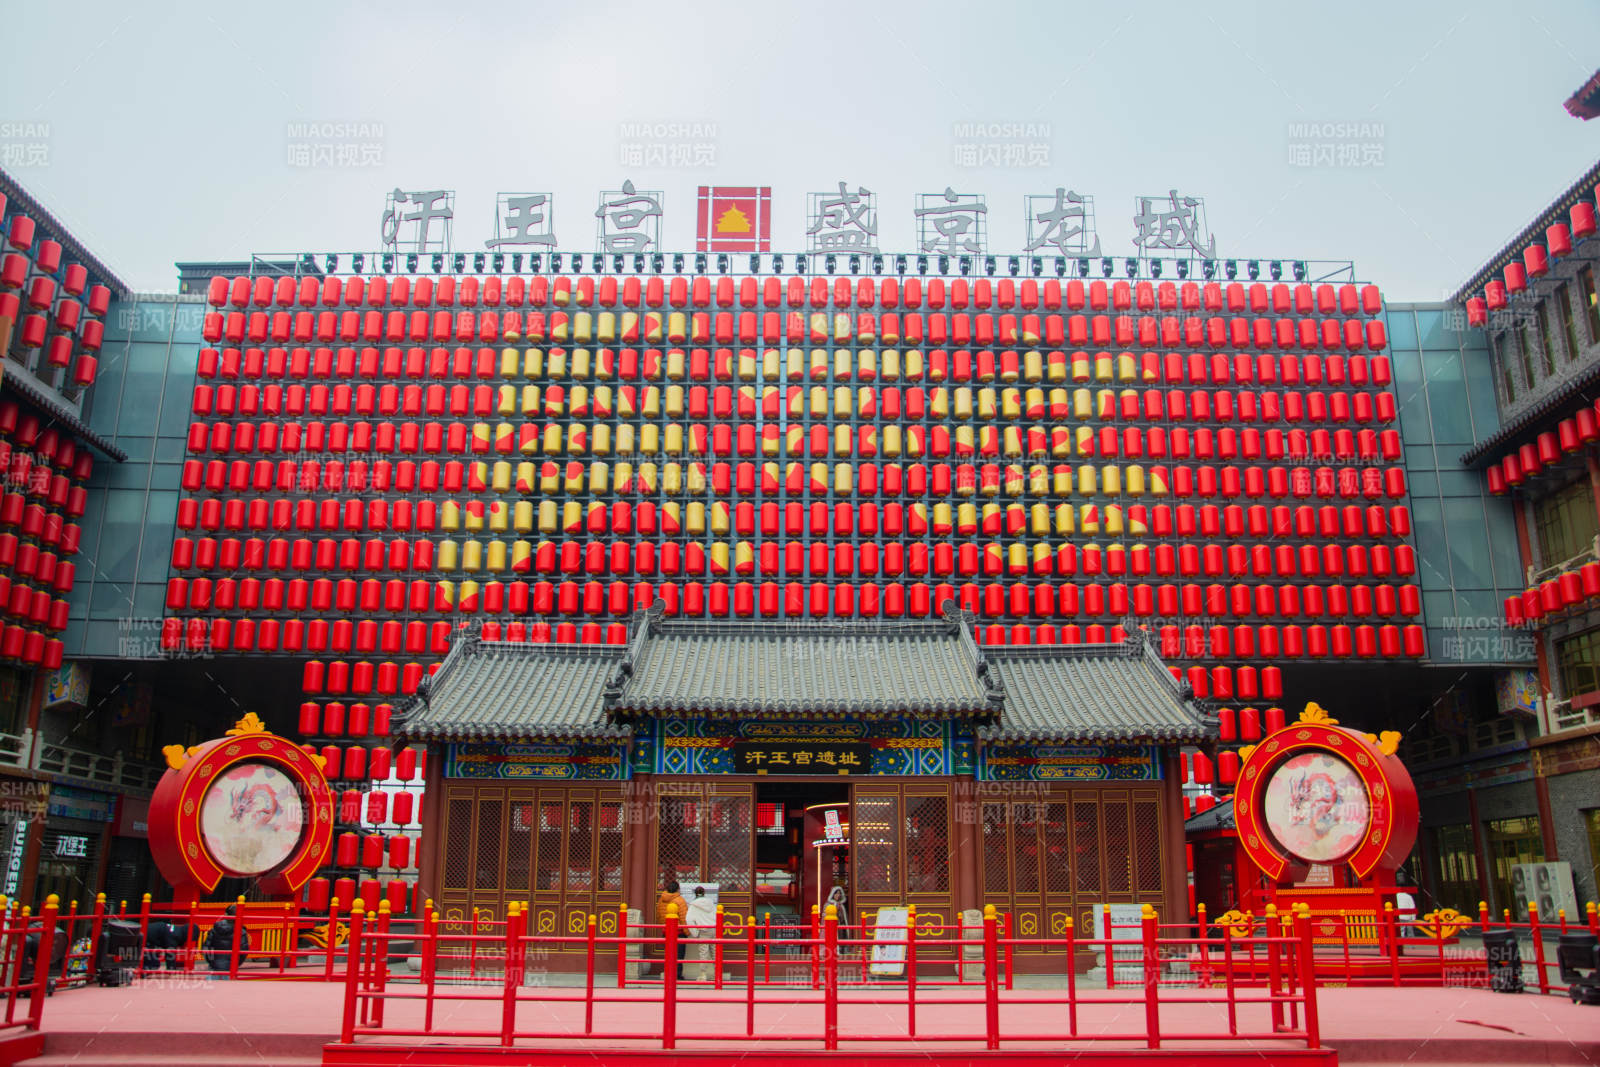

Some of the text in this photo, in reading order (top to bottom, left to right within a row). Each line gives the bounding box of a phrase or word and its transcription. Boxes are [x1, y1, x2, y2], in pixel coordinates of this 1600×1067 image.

[381, 180, 1217, 260] 汗王宫 盛京龙城
[745, 751, 861, 766] 汗王宫遗址
[6, 820, 27, 895] BURGER
[56, 835, 89, 857] 汉堡王
